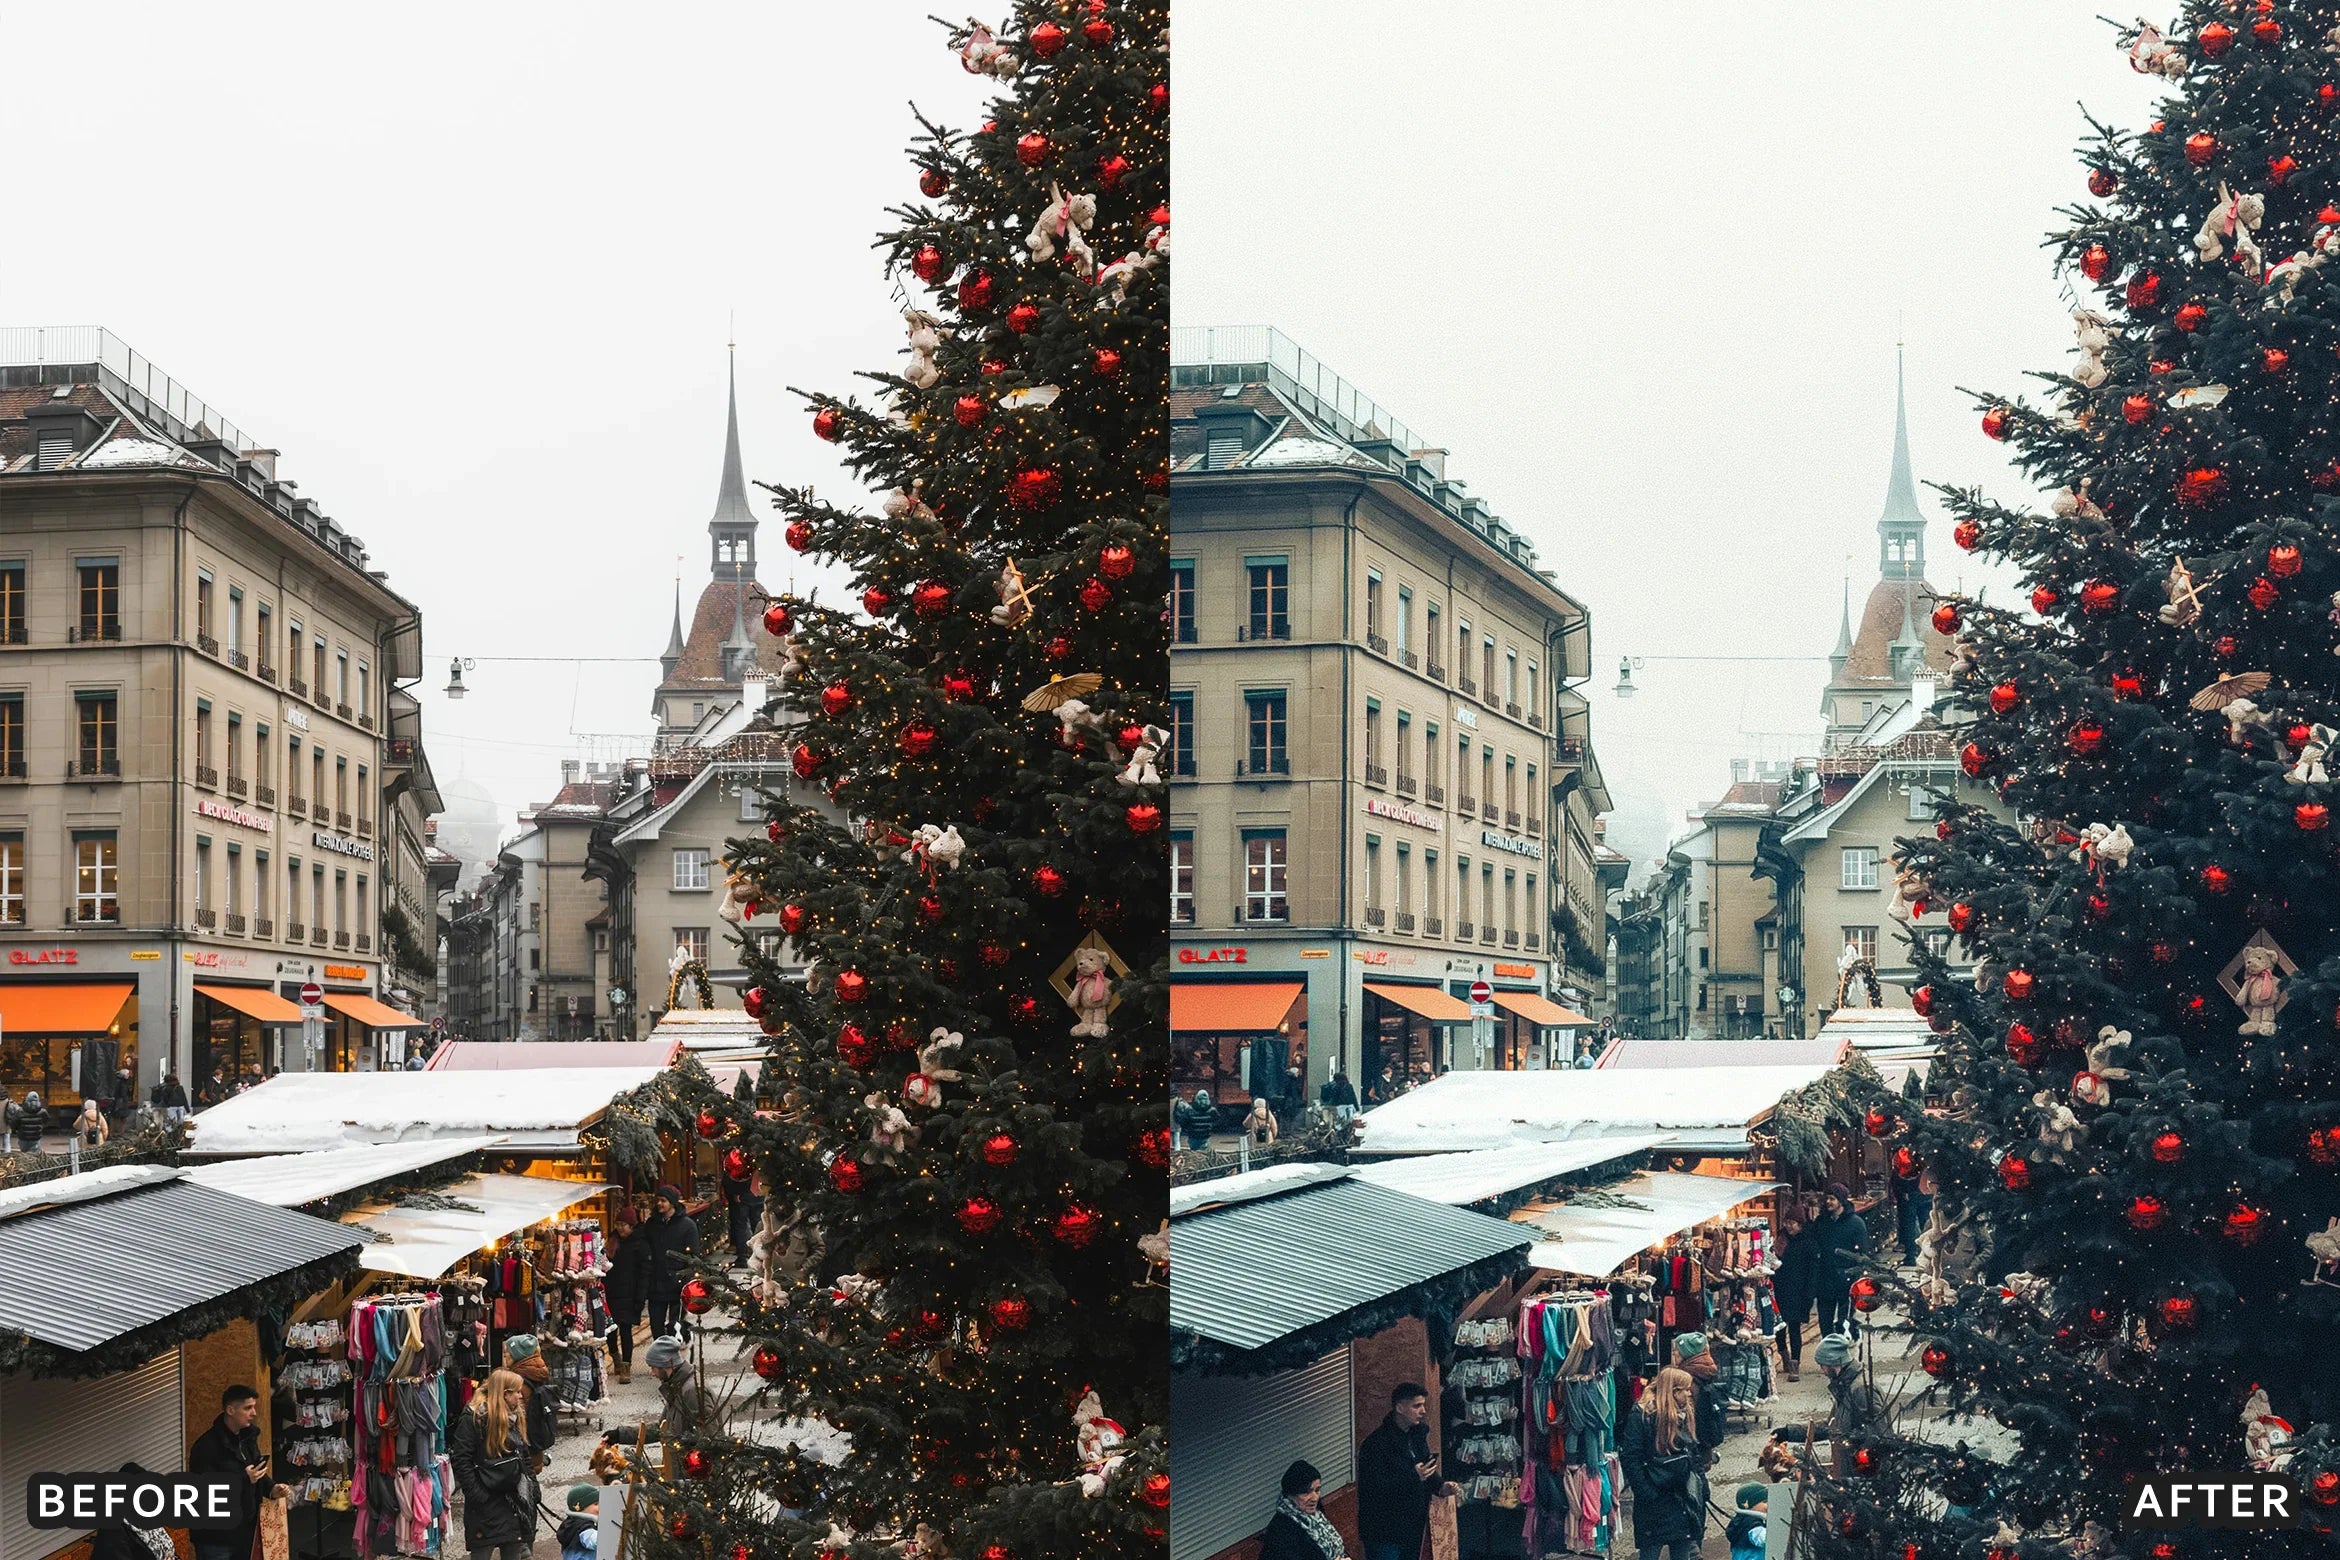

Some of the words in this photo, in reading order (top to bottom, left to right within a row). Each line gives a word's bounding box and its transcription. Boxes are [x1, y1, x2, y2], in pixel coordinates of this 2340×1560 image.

[203, 801, 221, 818] BECK
[221, 806, 241, 824] GLATZ
[241, 811, 273, 833] CONFISEUR
[1373, 800, 1390, 817] BECK
[1391, 805, 1411, 823] GLATZ
[9, 949, 78, 965] GLATZ
[1178, 947, 1248, 964] GLATZ
